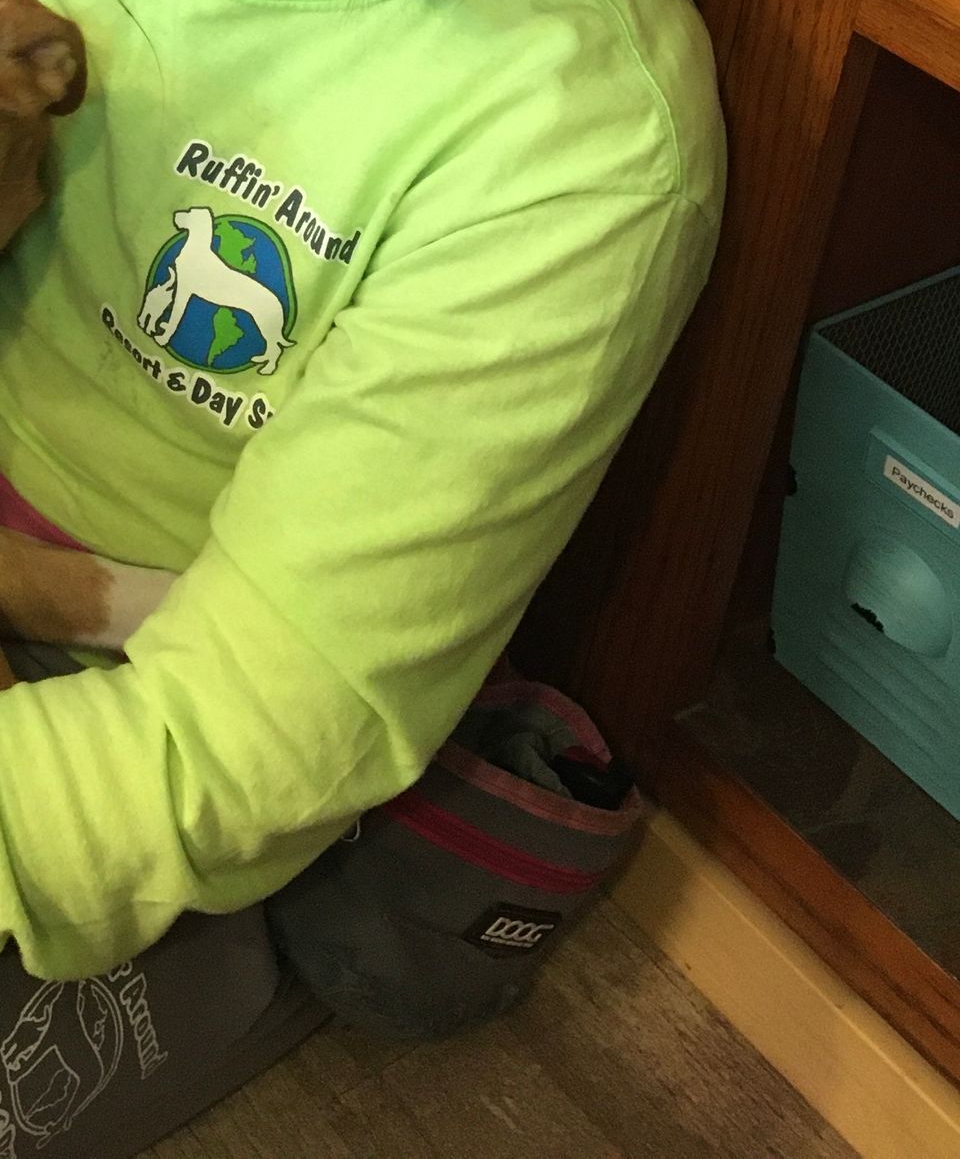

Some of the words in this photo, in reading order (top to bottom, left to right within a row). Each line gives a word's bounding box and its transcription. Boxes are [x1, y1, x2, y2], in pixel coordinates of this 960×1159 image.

[273, 187, 362, 266] Around
[100, 305, 163, 381] Resort
[166, 370, 188, 393] &
[189, 375, 245, 428] Day
[890, 465, 955, 521] Paychecks
[484, 915, 555, 944] DOOG
